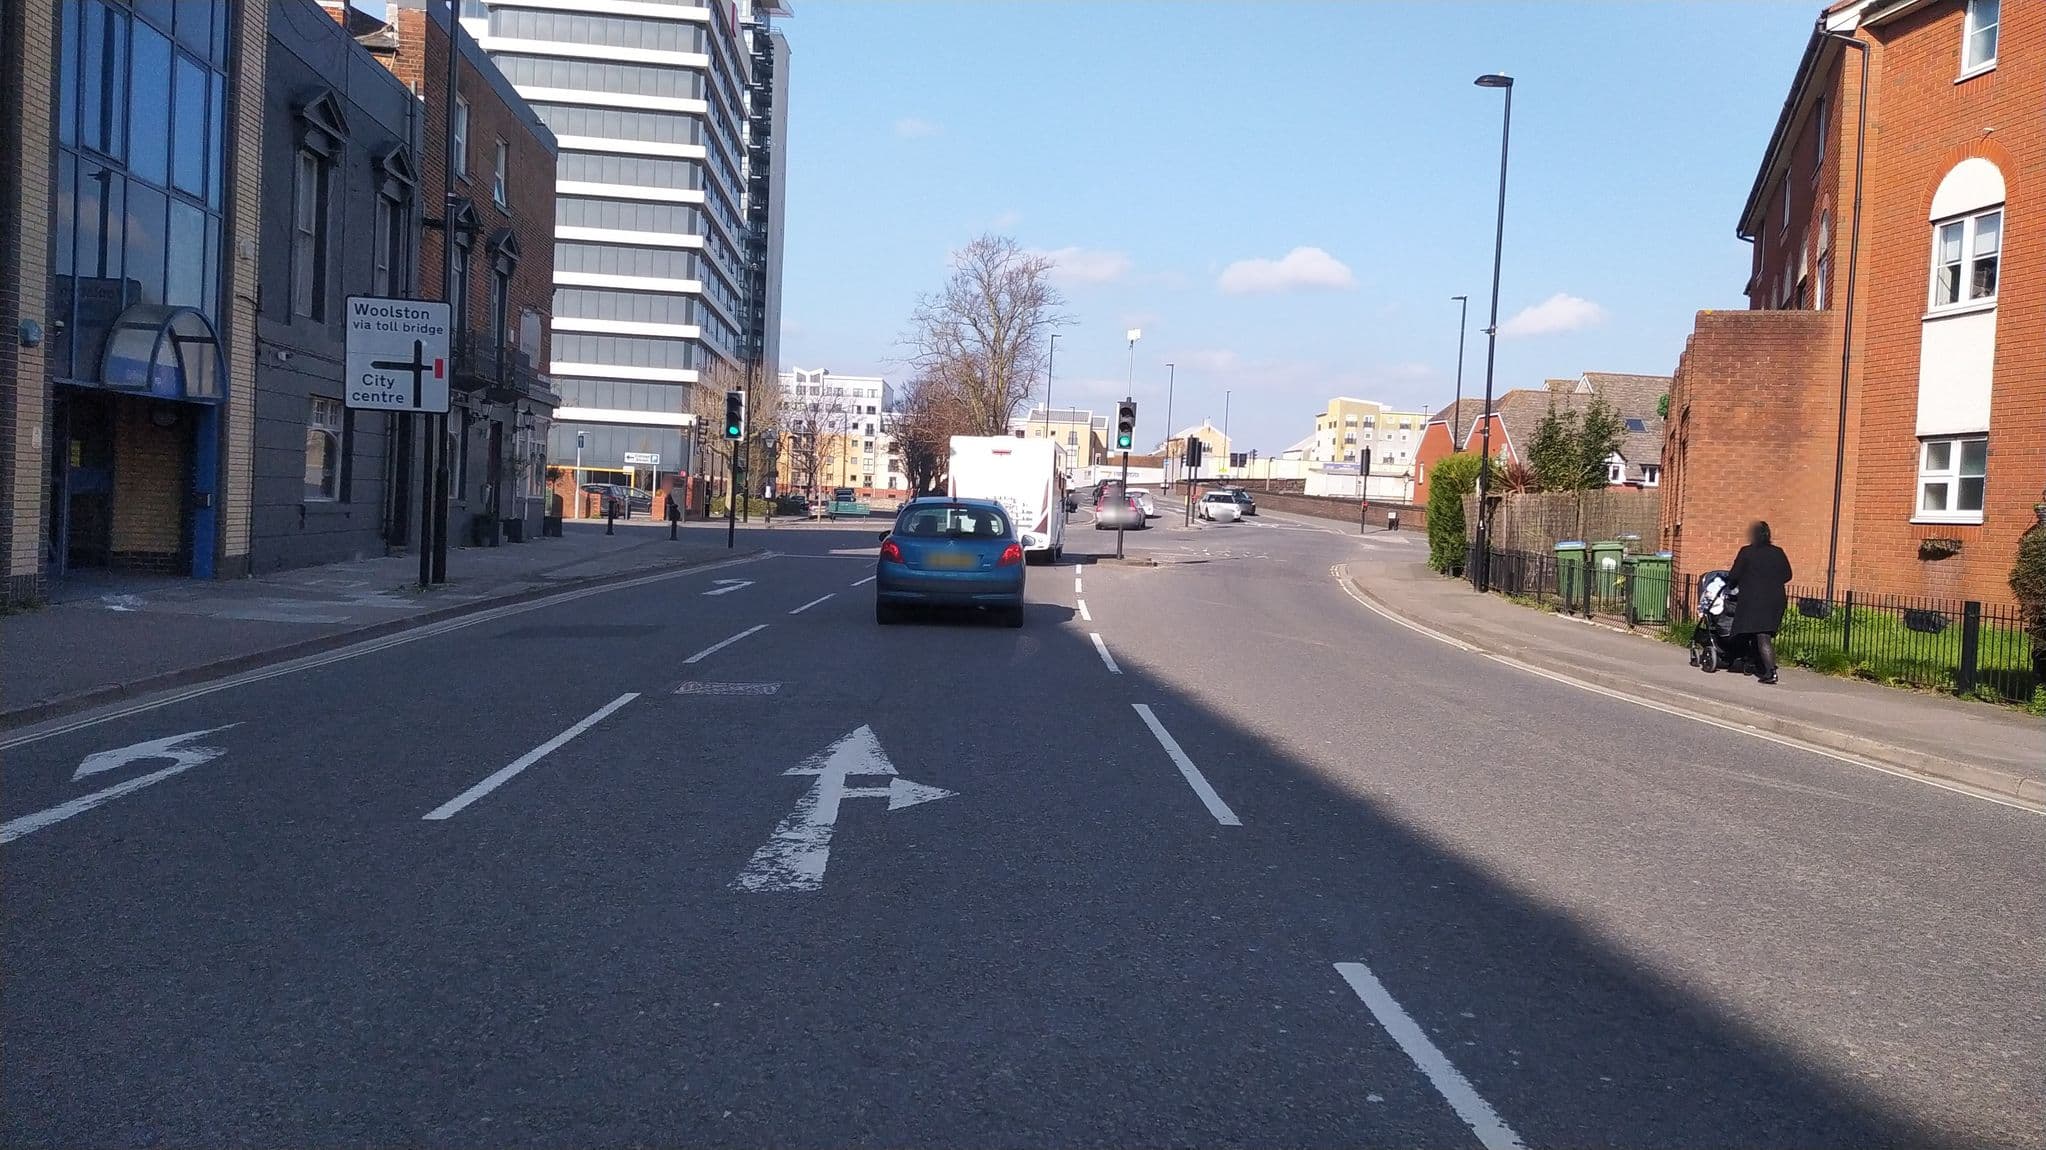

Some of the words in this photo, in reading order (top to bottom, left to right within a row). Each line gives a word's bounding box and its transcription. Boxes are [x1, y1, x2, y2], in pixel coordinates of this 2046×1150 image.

[354, 303, 430, 319] Woolston
[353, 320, 371, 330] via
[376, 321, 398, 332] toll
[403, 323, 443, 336] bridge
[362, 373, 395, 390] City
[352, 391, 404, 403] centre
